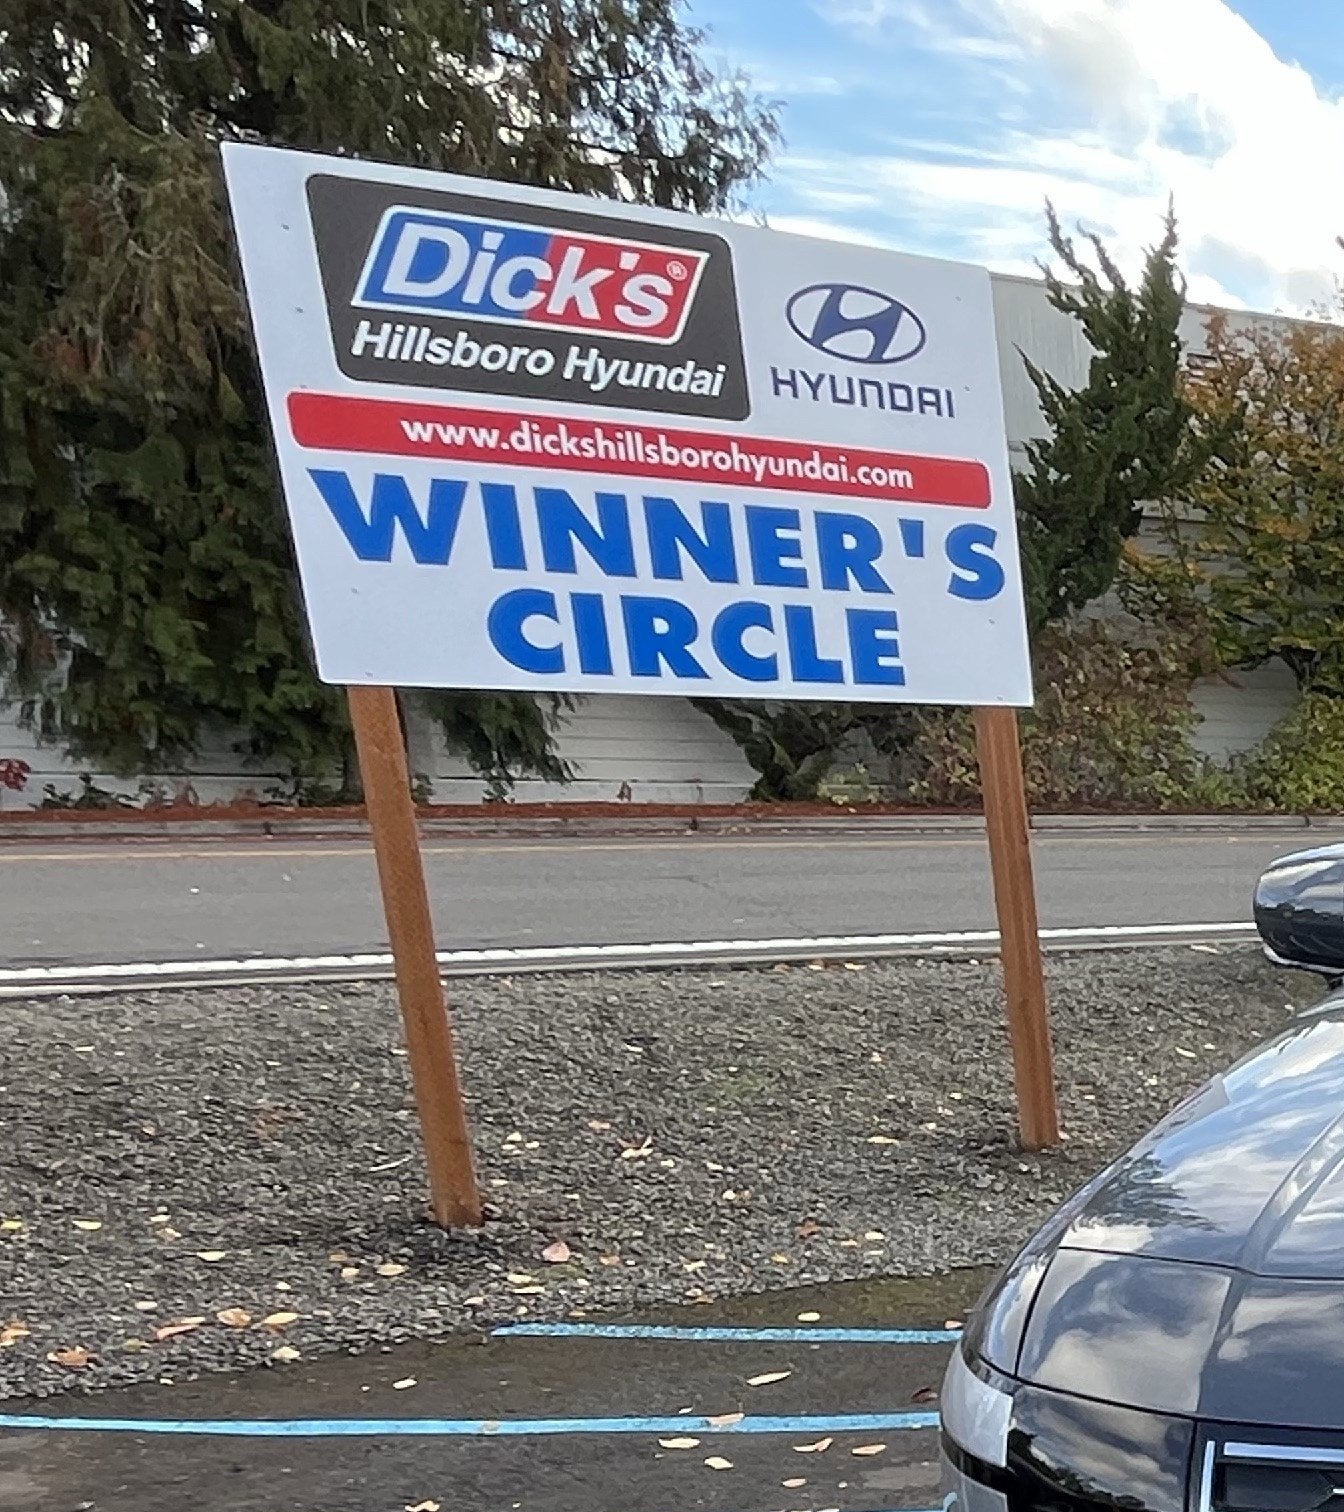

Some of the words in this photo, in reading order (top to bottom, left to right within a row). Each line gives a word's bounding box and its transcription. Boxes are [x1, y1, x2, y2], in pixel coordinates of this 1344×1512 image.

[350, 320, 555, 376] Hillsboro
[562, 346, 726, 398] Hyundai
[770, 366, 956, 418] HYUNDAI
[401, 419, 914, 491] www.dickshillsborohyundai.com
[306, 467, 1006, 601] WINNER'S
[486, 588, 906, 686] CIRCLE
